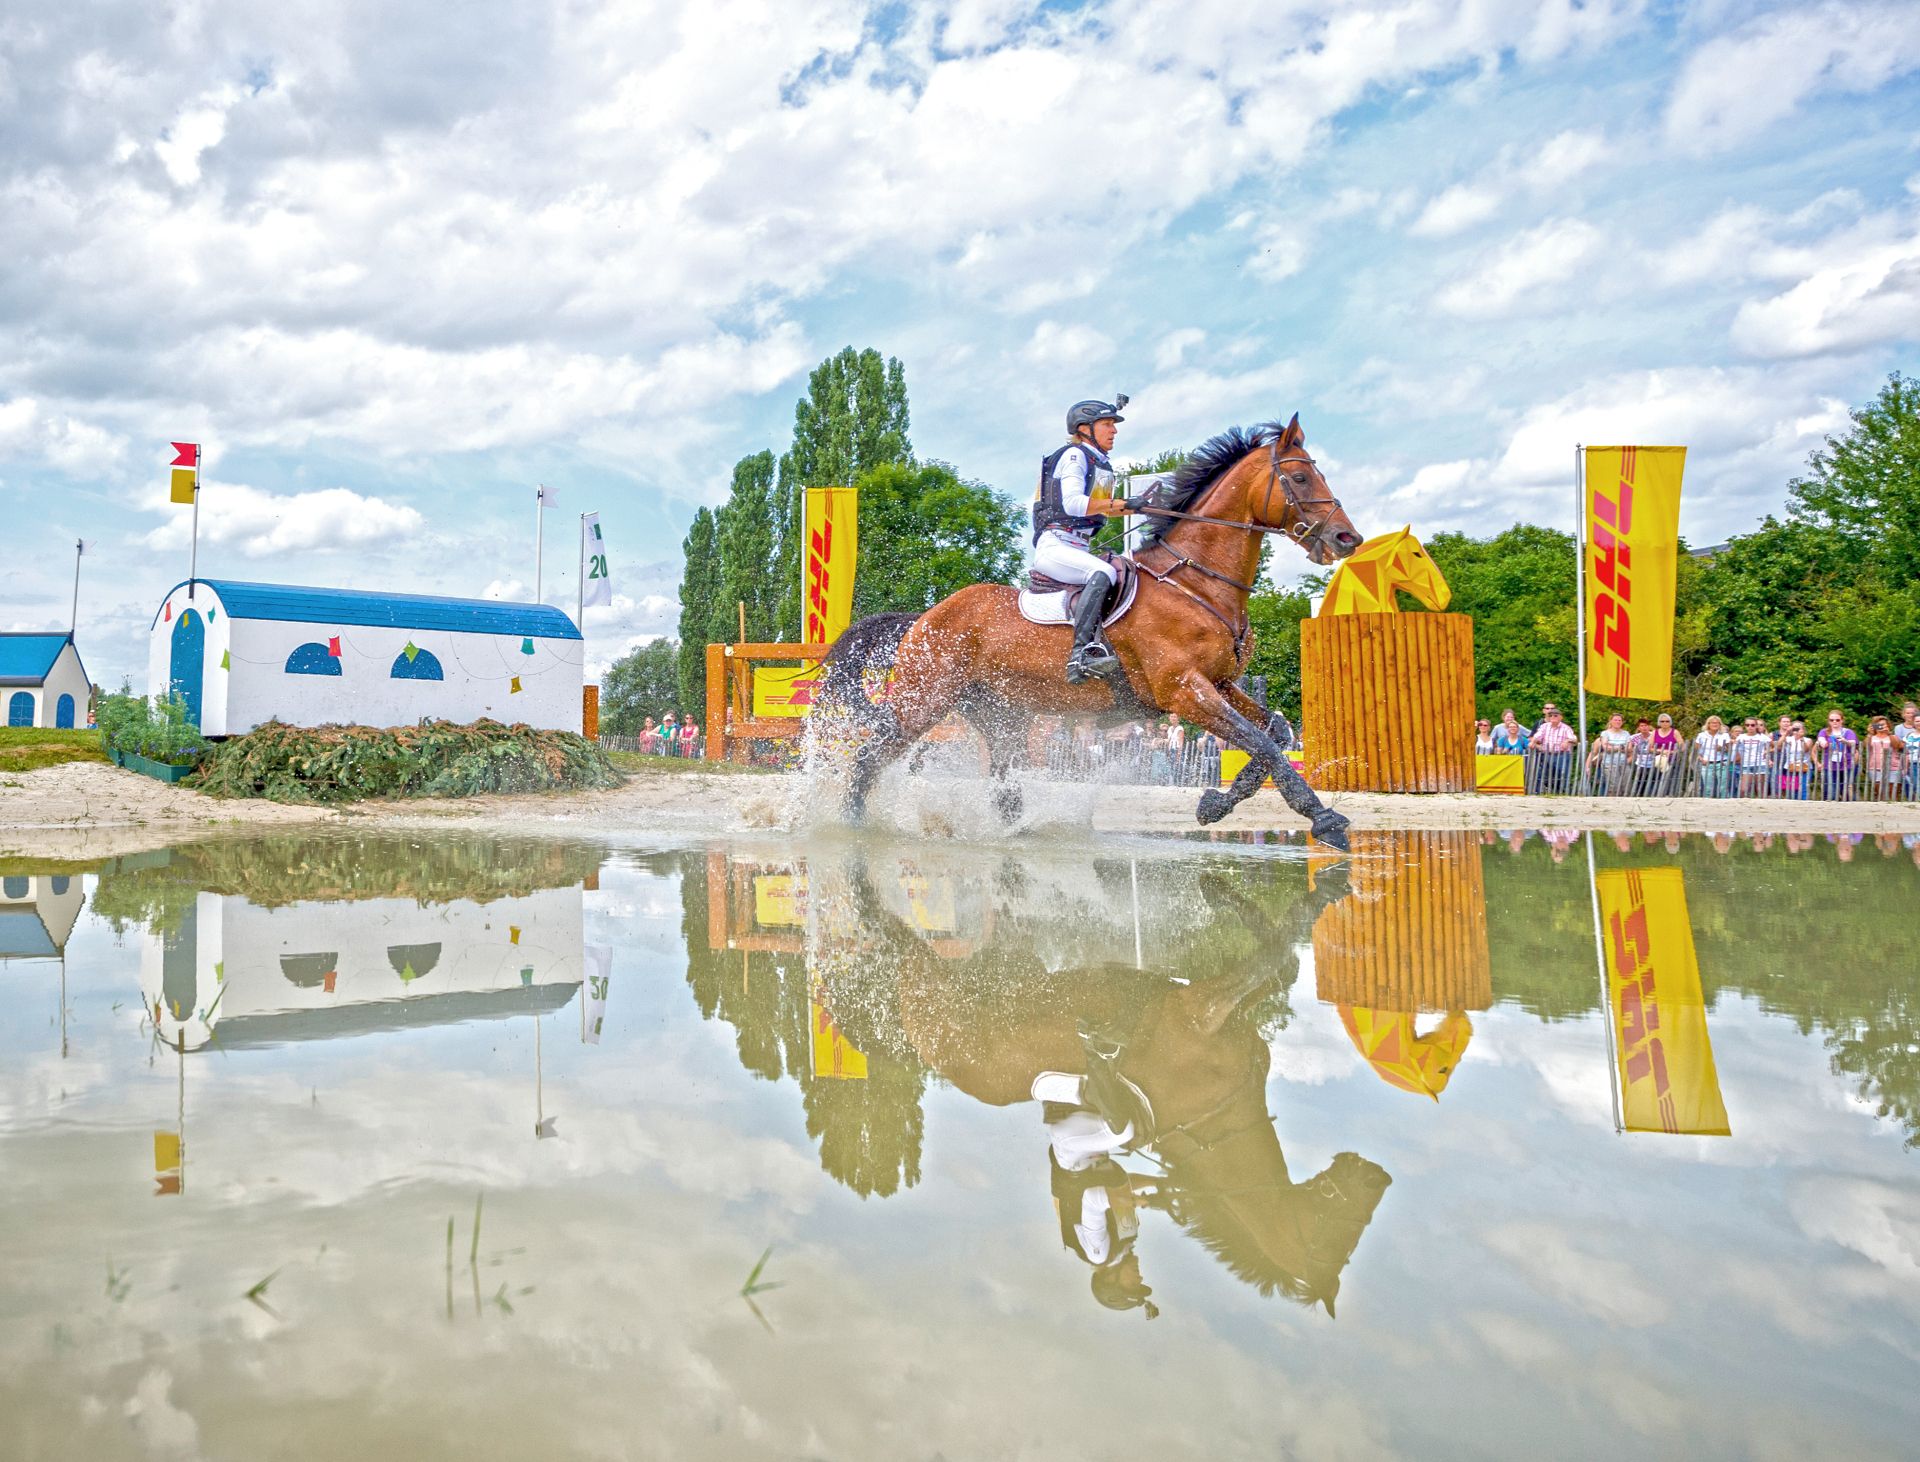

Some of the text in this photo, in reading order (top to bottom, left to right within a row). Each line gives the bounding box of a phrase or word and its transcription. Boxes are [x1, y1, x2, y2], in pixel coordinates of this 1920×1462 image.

[588, 553, 608, 579] 20
[808, 518, 832, 645] DHL
[1592, 479, 1634, 658] DHL
